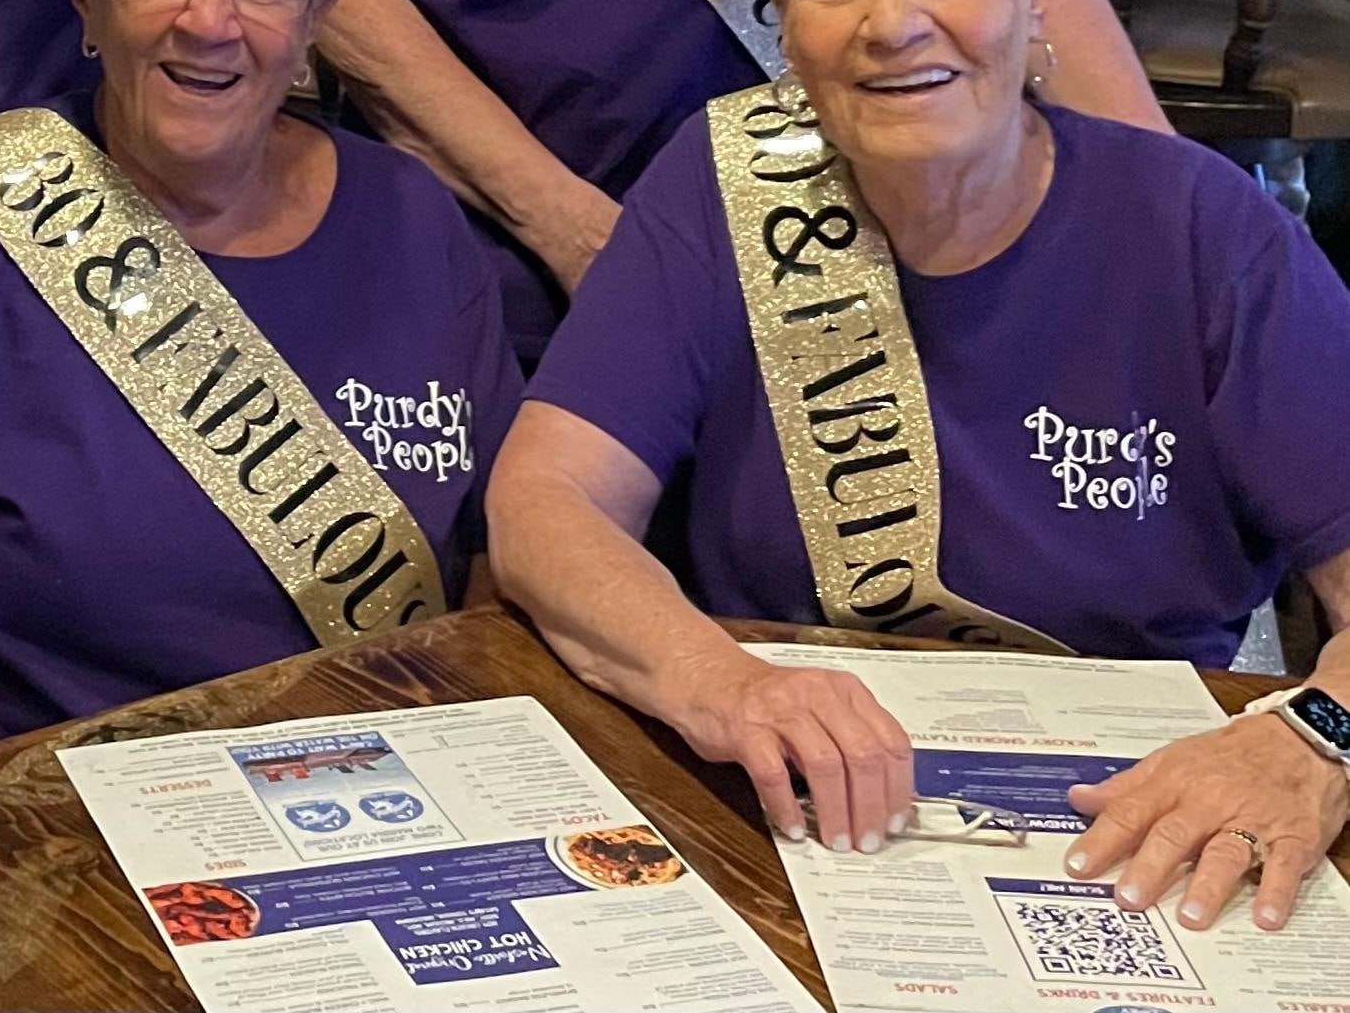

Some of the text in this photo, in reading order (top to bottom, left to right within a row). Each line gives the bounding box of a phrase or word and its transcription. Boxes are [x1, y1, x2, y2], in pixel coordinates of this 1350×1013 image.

[762, 205, 858, 288] &
[73, 235, 162, 333] &
[362, 421, 474, 483] Peopl
[962, 735, 1028, 745] SMOKED
[1032, 738, 1099, 748] HICKORY
[139, 779, 212, 795] DESSERTS
[561, 812, 612, 826] TACOS
[204, 859, 248, 871] SIDES
[398, 930, 532, 960] HOT CHICKEN
[895, 982, 959, 996] SALADS
[1037, 987, 1101, 1000] DRINKS
[1126, 991, 1216, 1007] FEATURES
